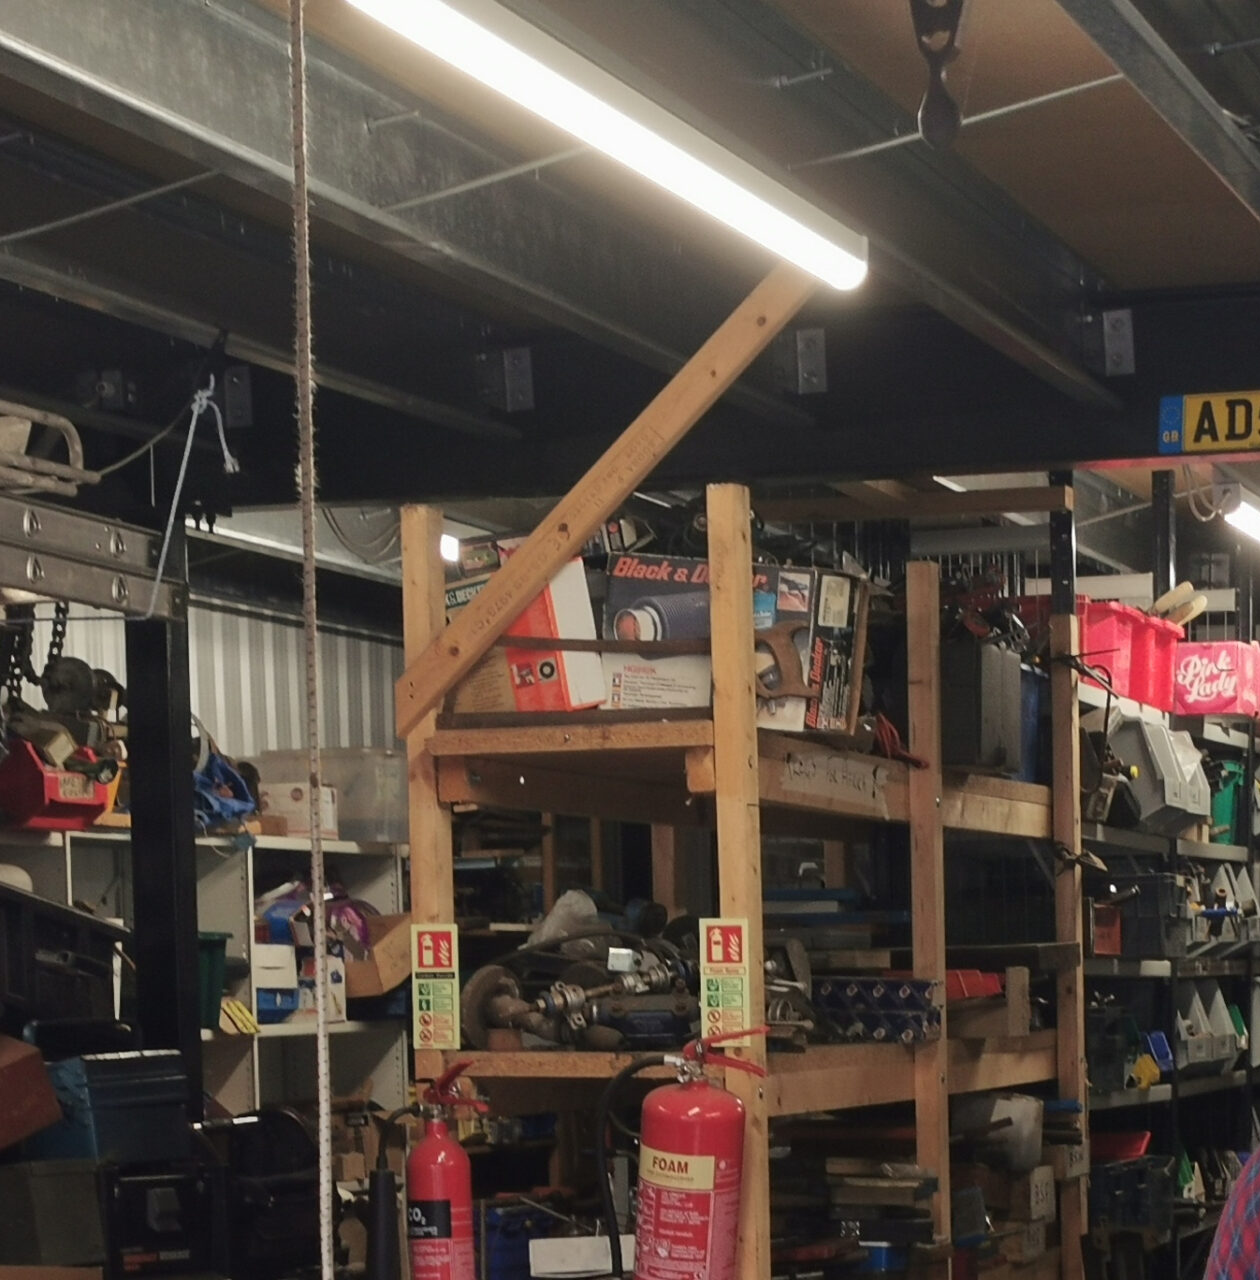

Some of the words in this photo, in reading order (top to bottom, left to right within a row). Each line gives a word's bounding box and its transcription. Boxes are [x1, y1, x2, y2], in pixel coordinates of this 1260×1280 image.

[1162, 431, 1179, 443] GB
[613, 556, 673, 582] Black
[673, 566, 689, 582] &
[1177, 650, 1232, 685] Pink
[1184, 671, 1238, 704] Lady
[652, 1155, 690, 1175] FOAM
